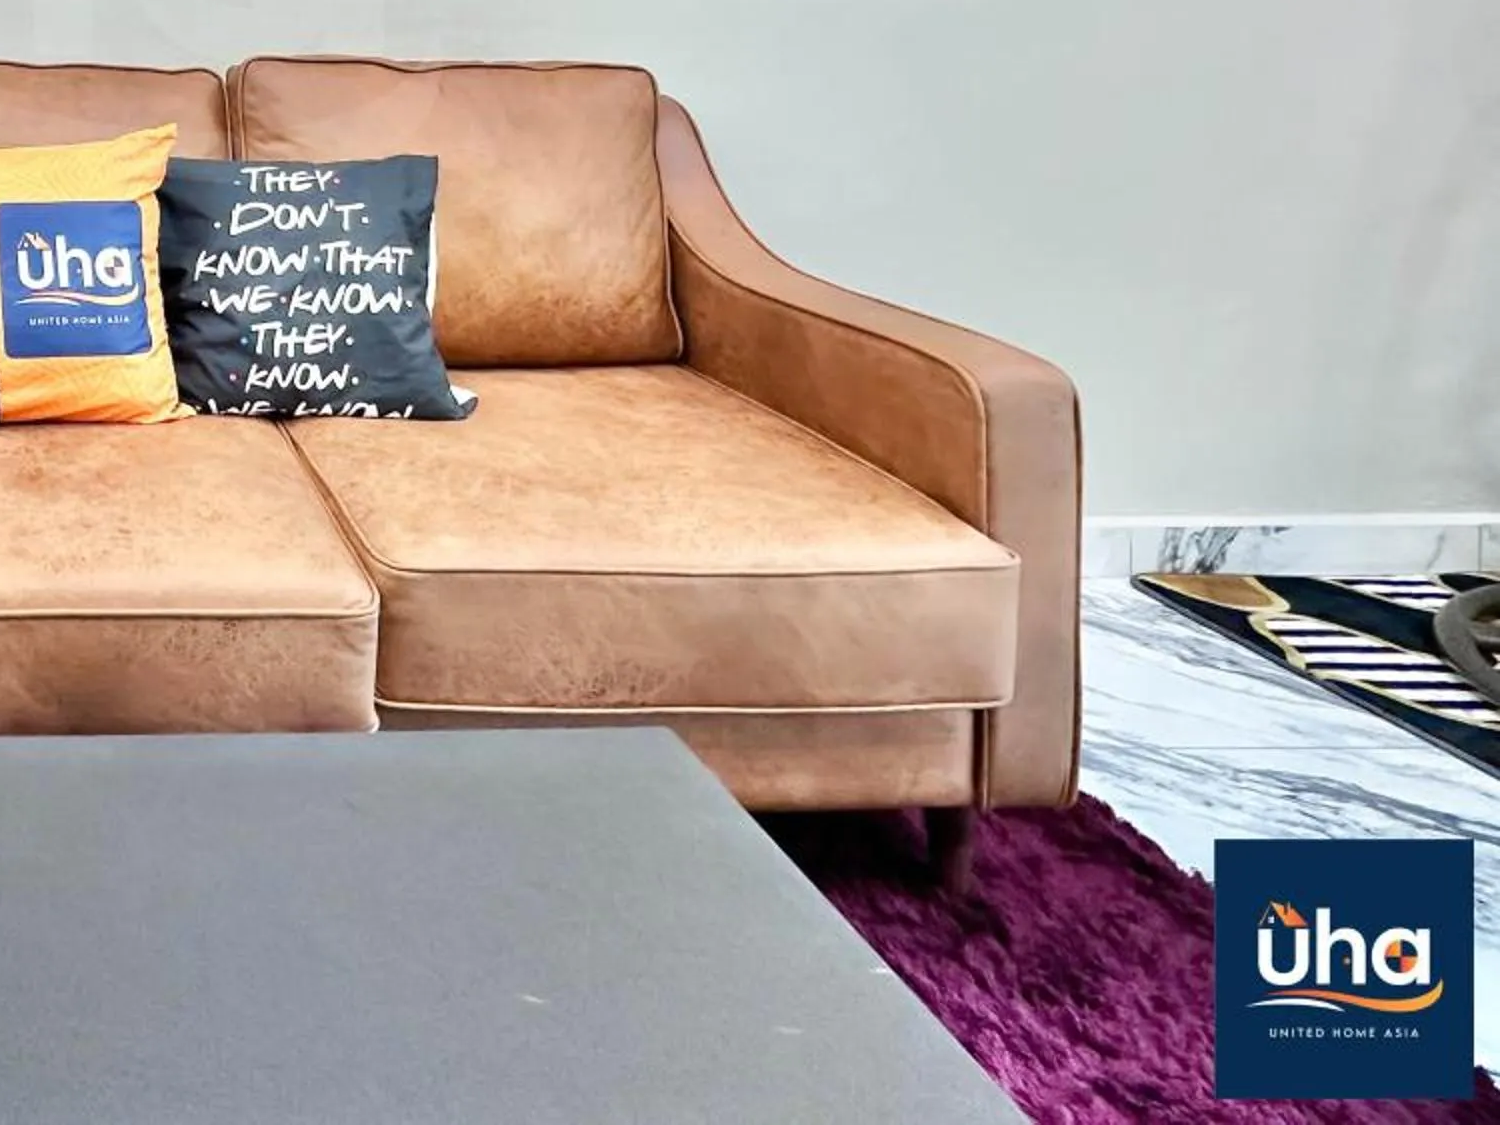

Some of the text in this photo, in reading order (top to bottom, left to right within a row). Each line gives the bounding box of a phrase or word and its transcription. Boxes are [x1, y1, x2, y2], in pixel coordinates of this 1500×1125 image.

[193, 241, 413, 281] KNOW THAT
[29, 315, 131, 326] UNITED HOME ASIA
